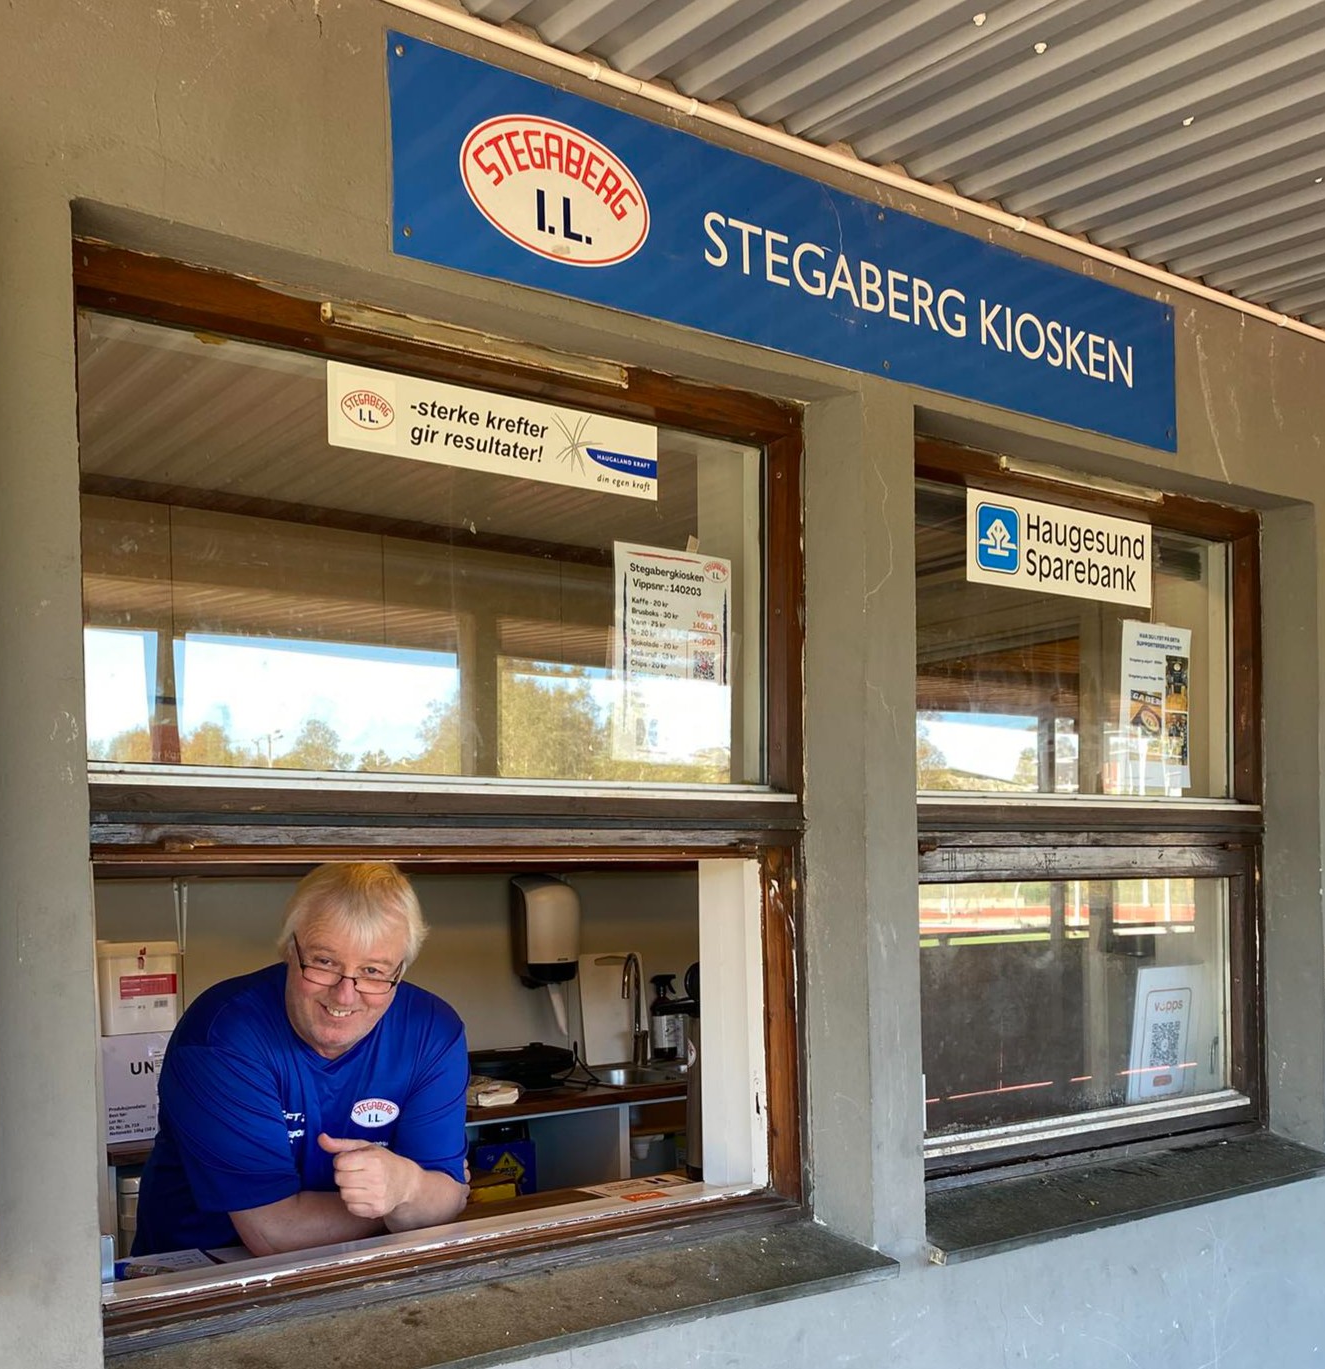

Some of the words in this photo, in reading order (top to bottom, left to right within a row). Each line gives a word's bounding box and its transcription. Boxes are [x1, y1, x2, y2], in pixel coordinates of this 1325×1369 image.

[472, 130, 639, 221] STEGABERG
[703, 211, 967, 339] STEGABERG
[979, 298, 1134, 389] KIOSKEN
[343, 393, 392, 418] STEGABERG
[410, 401, 480, 426] -sterke
[486, 410, 549, 439] krefter
[410, 425, 439, 446] gir
[444, 431, 544, 463] resultater!
[596, 454, 632, 466] HAUGALAND
[633, 461, 651, 469] KRAFT
[596, 474, 610, 482] din
[612, 478, 630, 488] egen
[632, 480, 651, 492] kraft
[1026, 513, 1145, 561] Haugesund
[629, 562, 705, 583] Stegabergkiosken
[1025, 549, 1137, 592] Sparebank
[632, 578, 669, 592] Vippsnr.:
[670, 584, 702, 597] 140203
[631, 597, 649, 606] Kaffe
[653, 599, 661, 607] 20
[631, 607, 659, 618] Brusboks
[663, 611, 672, 619] 30
[672, 612, 679, 620] kr
[696, 610, 714, 620] Vipps
[640, 629, 649, 637] 20
[631, 638, 659, 650] Sjokolade
[663, 641, 672, 649] 20
[672, 642, 679, 650] kr
[630, 660, 647, 668] Chips
[651, 661, 660, 669] 20
[660, 662, 668, 670] kr
[130, 1061, 155, 1075] UN
[354, 1101, 396, 1116] STEGABERG
